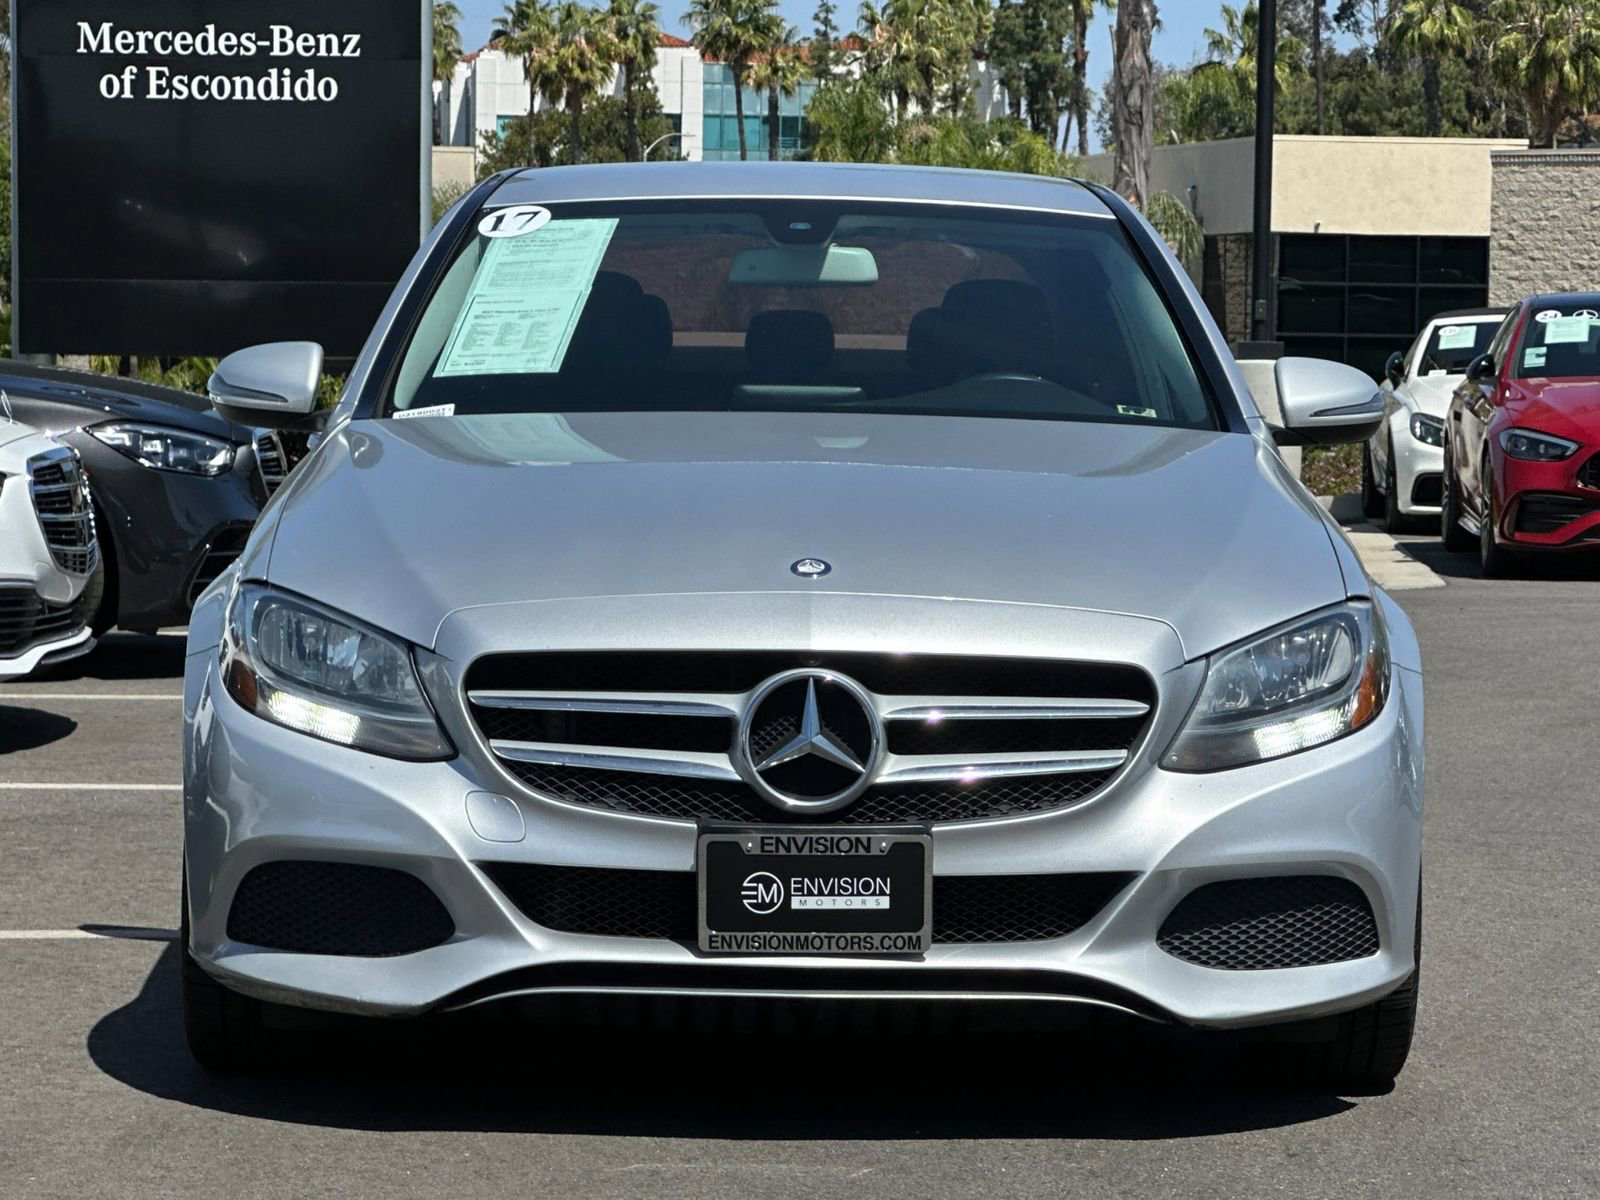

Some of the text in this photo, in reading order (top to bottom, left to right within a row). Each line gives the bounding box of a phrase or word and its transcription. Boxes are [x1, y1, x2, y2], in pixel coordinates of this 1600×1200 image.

[76, 21, 362, 58] Mercedes-Benz
[99, 65, 339, 103] of Escondido
[487, 209, 544, 234] 17
[760, 836, 872, 855] ENVISION
[790, 877, 891, 896] ENVISION
[798, 898, 882, 907] MOTORS
[708, 934, 922, 952] ENVISIONMOTORS.COM
